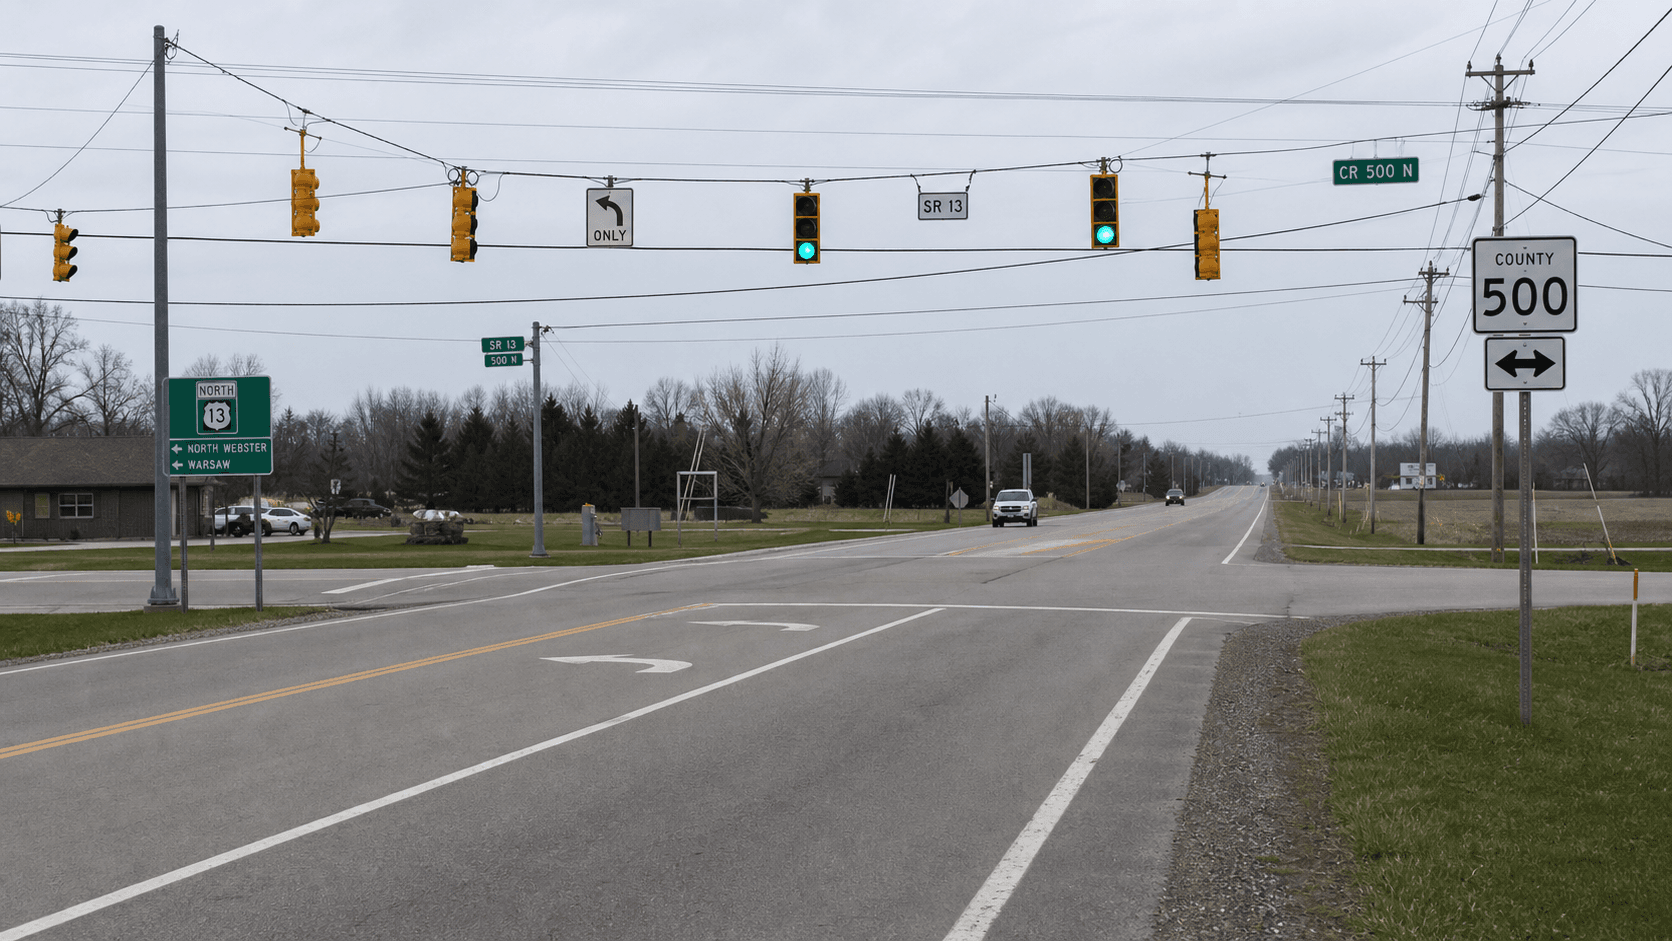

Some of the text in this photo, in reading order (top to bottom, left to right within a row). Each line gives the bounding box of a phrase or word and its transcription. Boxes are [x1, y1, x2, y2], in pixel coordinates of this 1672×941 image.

[1339, 163, 1413, 180] CR 500 N
[923, 199, 963, 213] SR 13
[593, 229, 627, 241] ONLY
[1495, 252, 1554, 266] COUNTY
[1483, 276, 1568, 317] 500
[490, 340, 517, 350] SR 13
[491, 355, 517, 365] 500 N
[199, 385, 234, 396] NORTH
[209, 407, 225, 423] 13
[187, 442, 267, 453] NORTH WEBSTER
[187, 459, 231, 469] WARSAW
